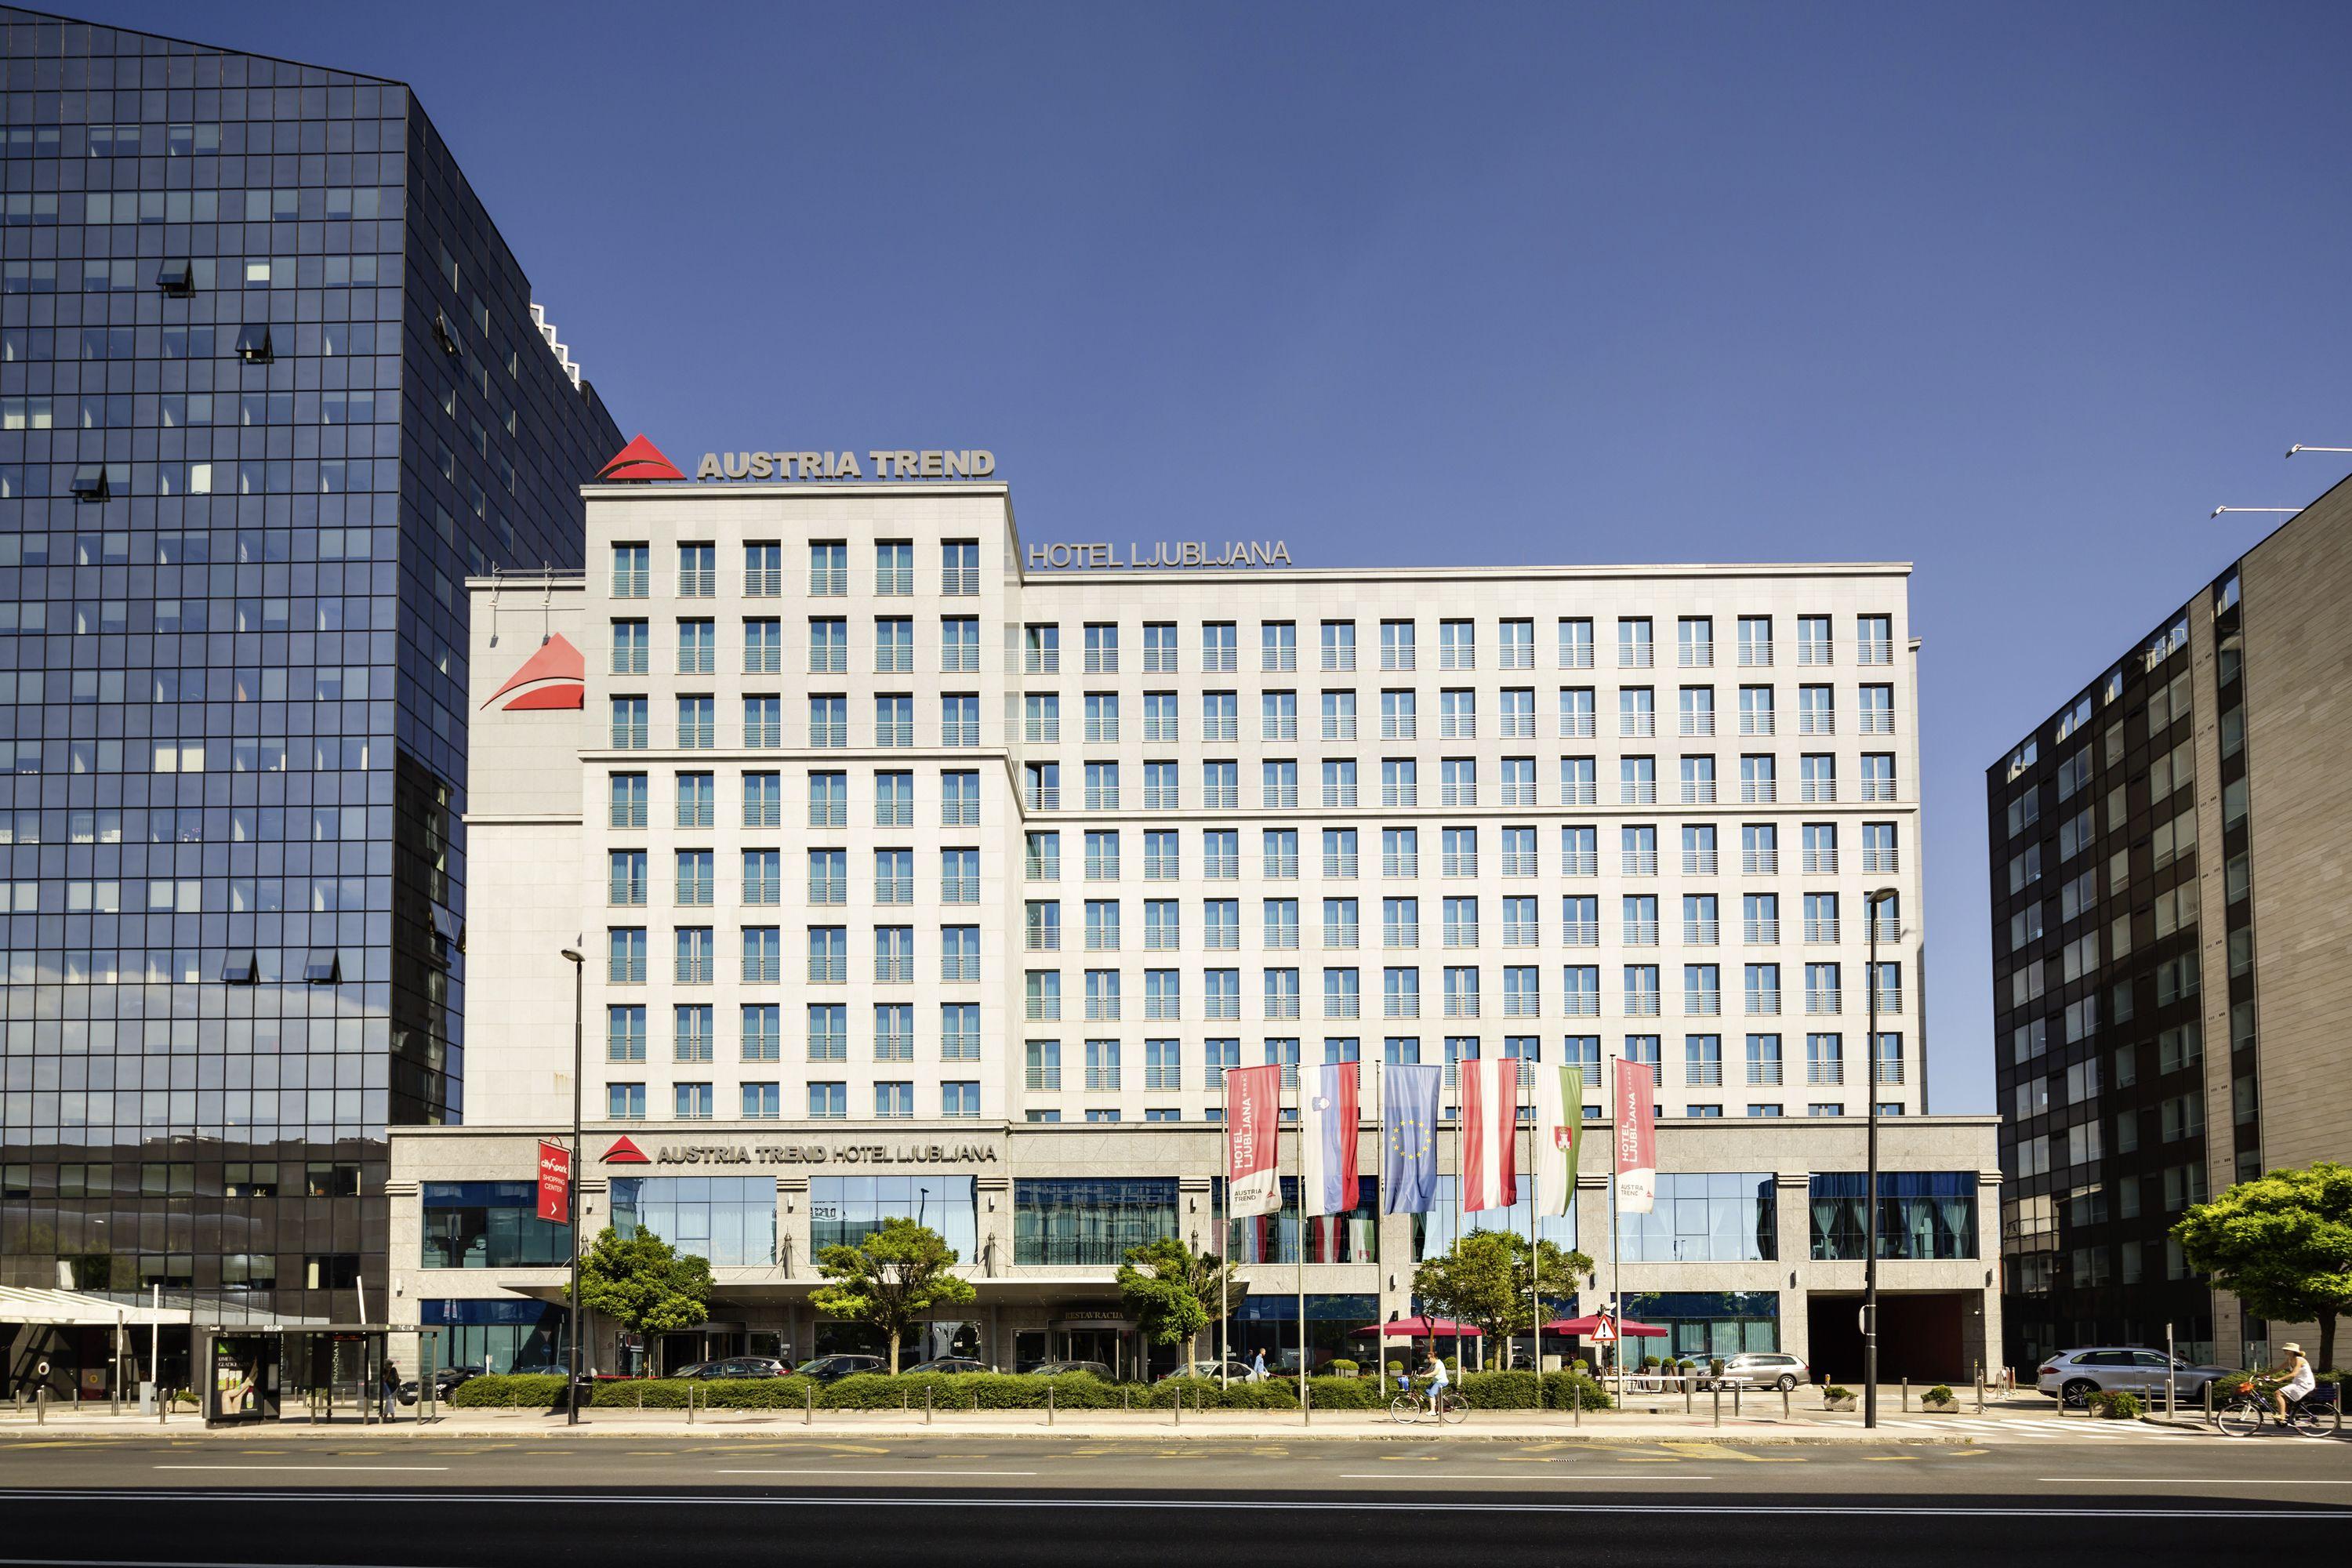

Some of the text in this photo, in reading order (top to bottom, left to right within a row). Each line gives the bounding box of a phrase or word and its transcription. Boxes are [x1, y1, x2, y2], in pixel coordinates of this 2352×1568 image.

[697, 449, 995, 480] AUSTRIA TREND
[1029, 540, 1292, 568] HOTEL LJUBLJANA
[1243, 1098, 1253, 1167] LJUBLJANA
[1628, 1093, 1637, 1162] LJUBLJANA
[657, 1144, 997, 1164] AUSTRIA TREND HOTEL LJUBLJANA
[1234, 1129, 1243, 1169] HOTEL
[543, 1174, 564, 1185] SHOPPING
[544, 1182, 562, 1192] CENTER
[1234, 1188, 1262, 1196] AUSTRIA
